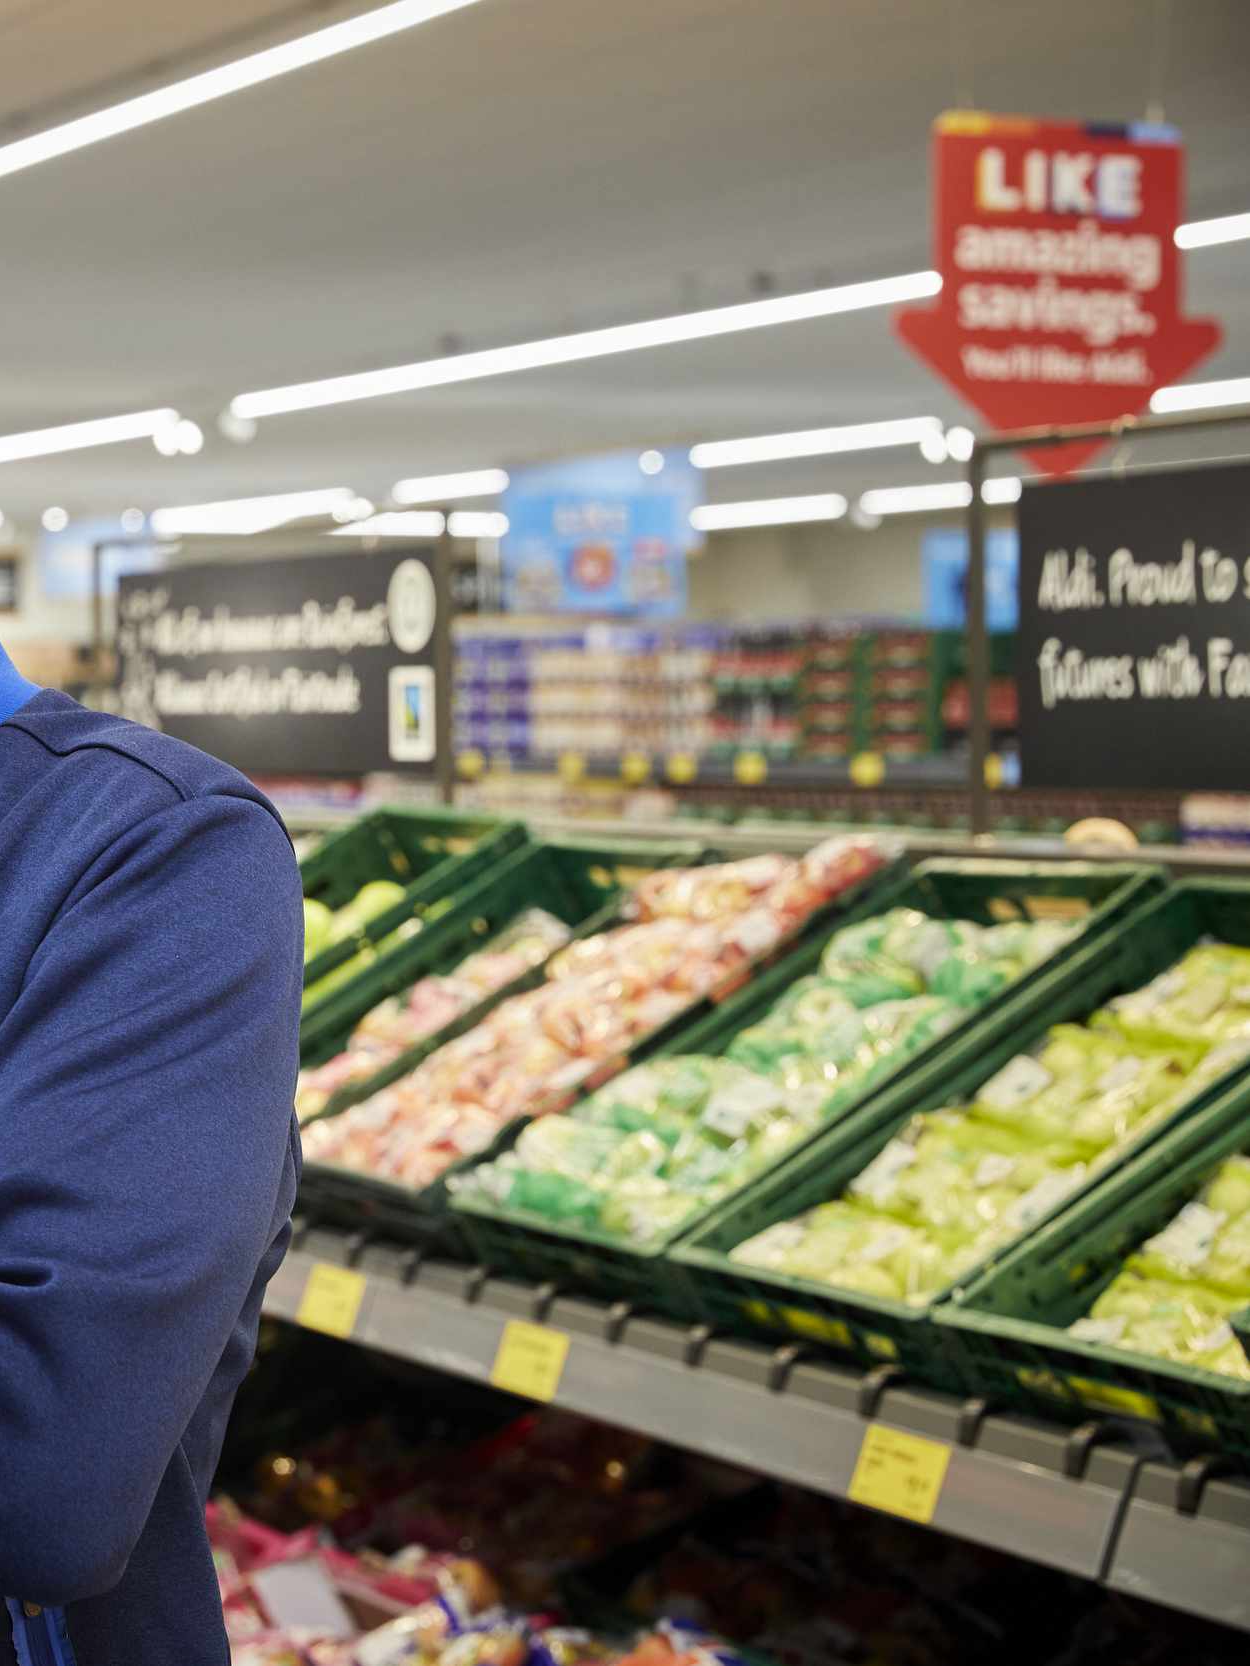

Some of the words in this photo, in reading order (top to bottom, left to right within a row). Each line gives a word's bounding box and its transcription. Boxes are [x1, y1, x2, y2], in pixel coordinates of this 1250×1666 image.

[975, 147, 1143, 219] LIKE
[953, 219, 1161, 291] amazing
[956, 277, 1157, 346] savings.
[1039, 546, 1105, 611] Aldi.
[1107, 539, 1197, 606] Proud
[1199, 546, 1238, 603] to
[1037, 638, 1135, 709] futures
[1137, 635, 1204, 698] with
